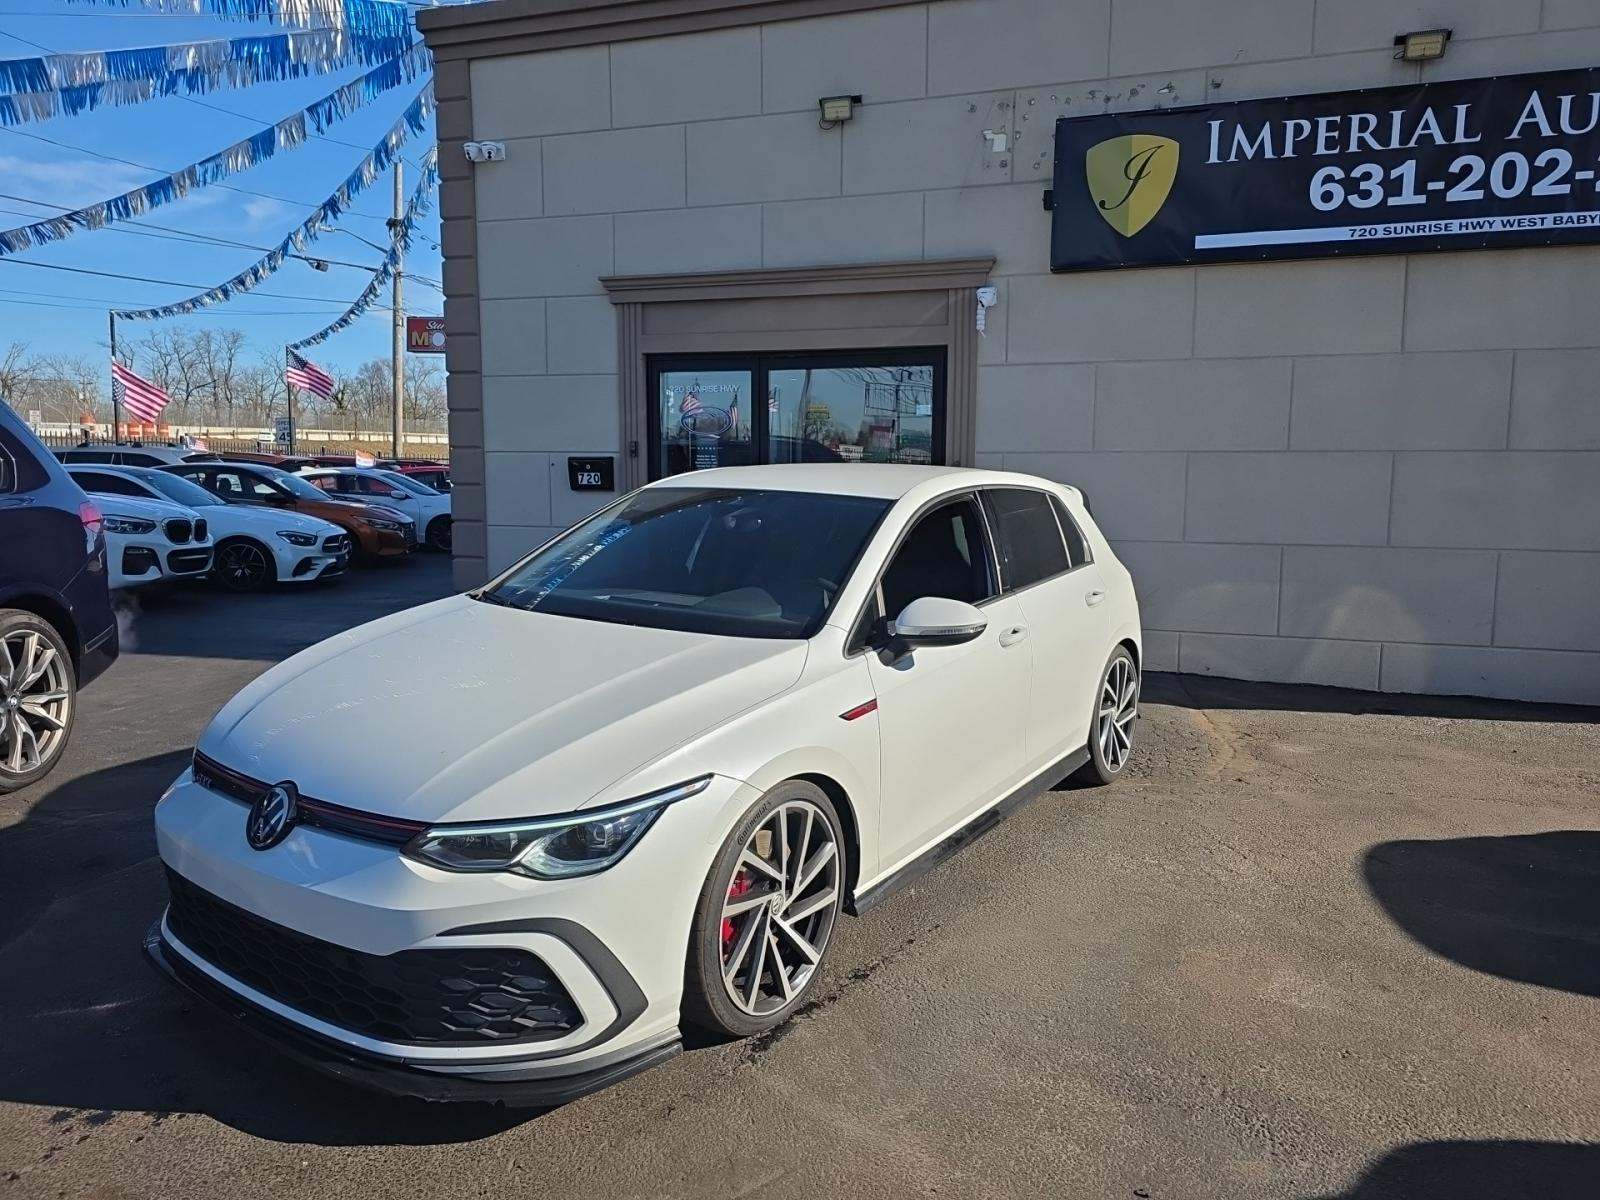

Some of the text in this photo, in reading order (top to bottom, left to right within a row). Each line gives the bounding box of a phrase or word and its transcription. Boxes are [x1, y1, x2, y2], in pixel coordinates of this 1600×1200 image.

[1205, 104, 1481, 164] IMPERIAL
[1309, 148, 1600, 212] 631-202-
[1349, 213, 1600, 239] 720 SUNRISE HWY WEST BABY
[578, 473, 600, 484] 720
